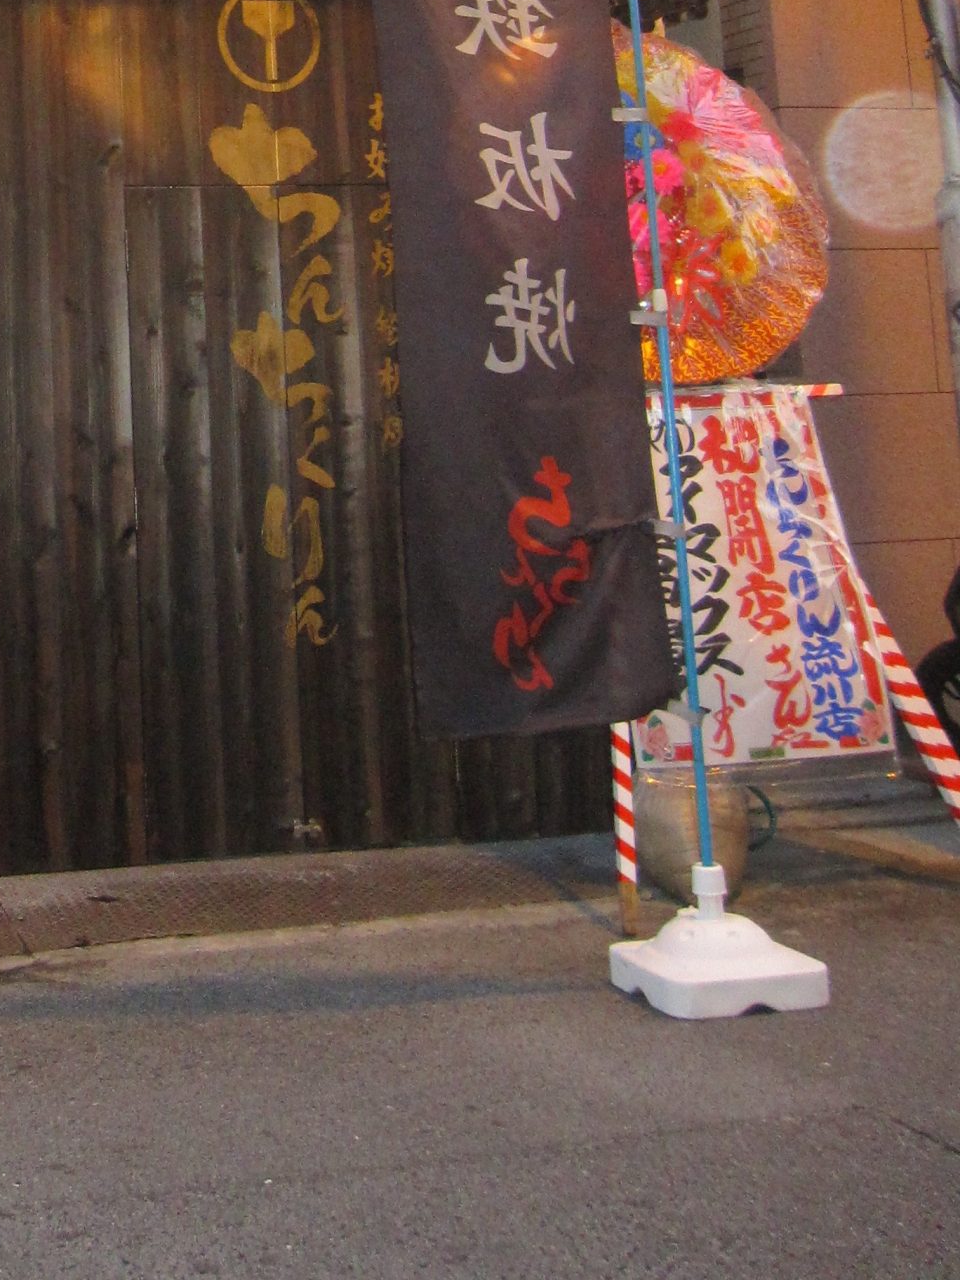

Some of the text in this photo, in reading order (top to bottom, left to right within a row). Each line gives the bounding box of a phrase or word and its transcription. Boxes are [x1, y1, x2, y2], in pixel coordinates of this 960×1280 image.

[209, 103, 345, 649] ちんちくりん
